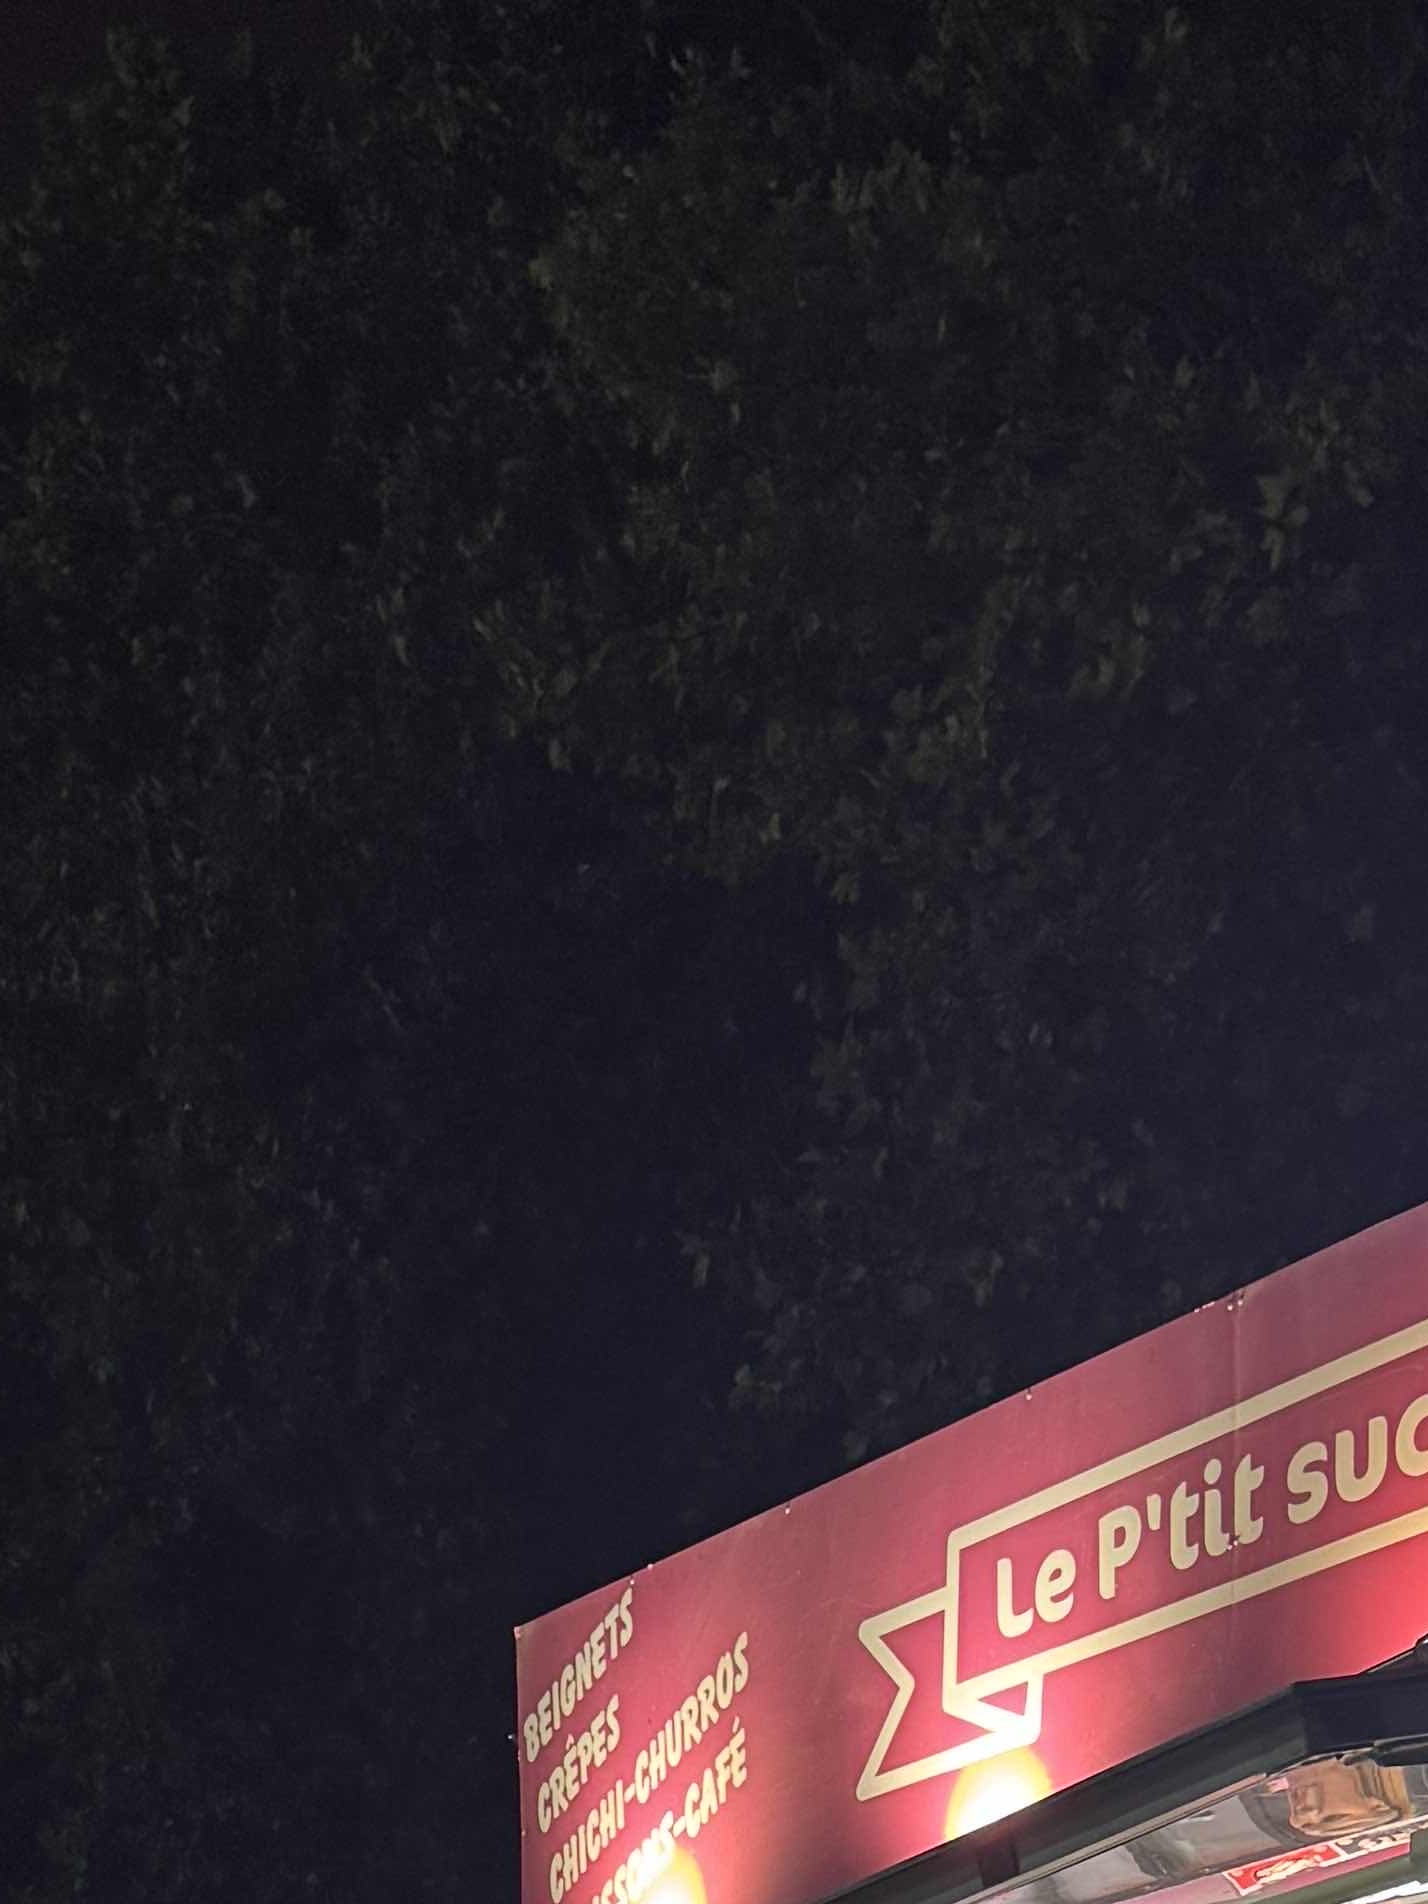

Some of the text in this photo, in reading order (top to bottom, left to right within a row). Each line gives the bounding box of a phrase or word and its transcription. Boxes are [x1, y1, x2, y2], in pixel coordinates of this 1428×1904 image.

[995, 1548, 1076, 1638] Le
[1098, 1452, 1265, 1600] P'tit
[523, 1587, 633, 1763] BEIGNETS
[537, 1694, 620, 1833] CRÊPES
[549, 1631, 749, 1904] CHICHI-CHURROS
